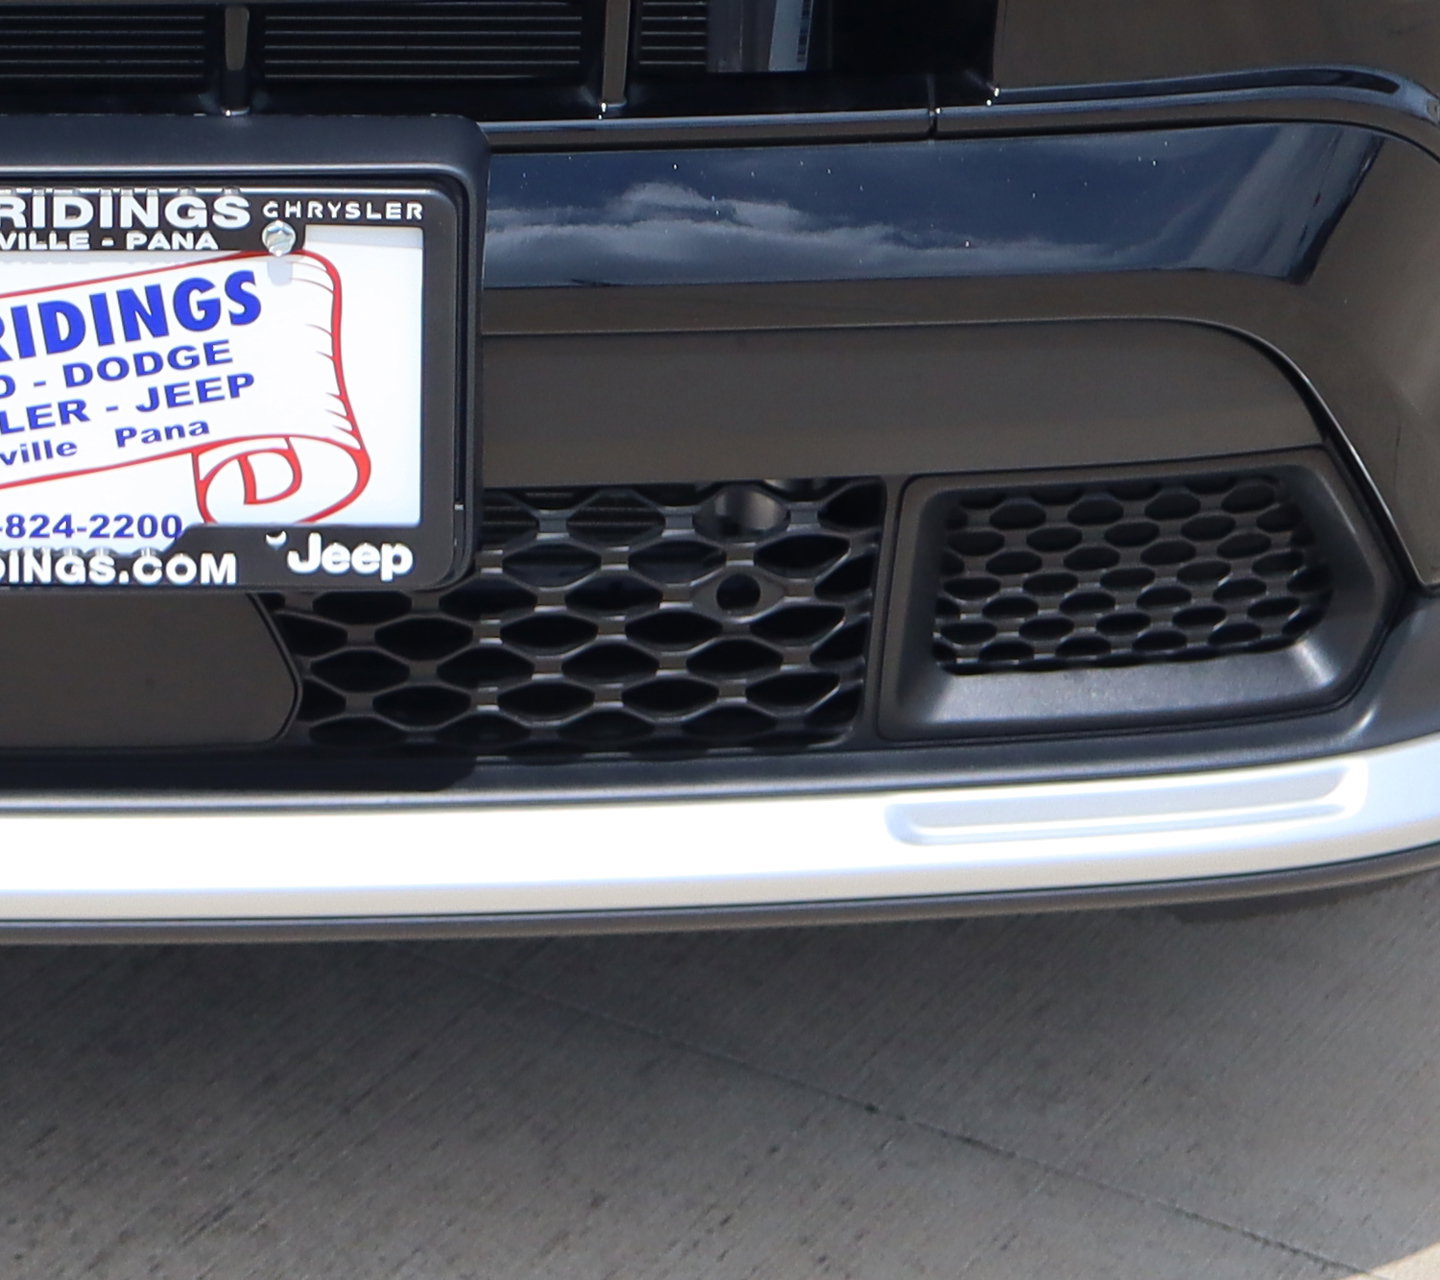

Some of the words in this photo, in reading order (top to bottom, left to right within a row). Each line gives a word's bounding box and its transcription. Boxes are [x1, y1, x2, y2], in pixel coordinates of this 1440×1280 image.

[262, 200, 424, 221] CHRYSLER
[125, 230, 219, 251] PANA
[62, 339, 234, 389] DODGE
[135, 372, 255, 413] JEEP
[114, 419, 210, 449] Pana
[286, 532, 414, 583] Jeep
